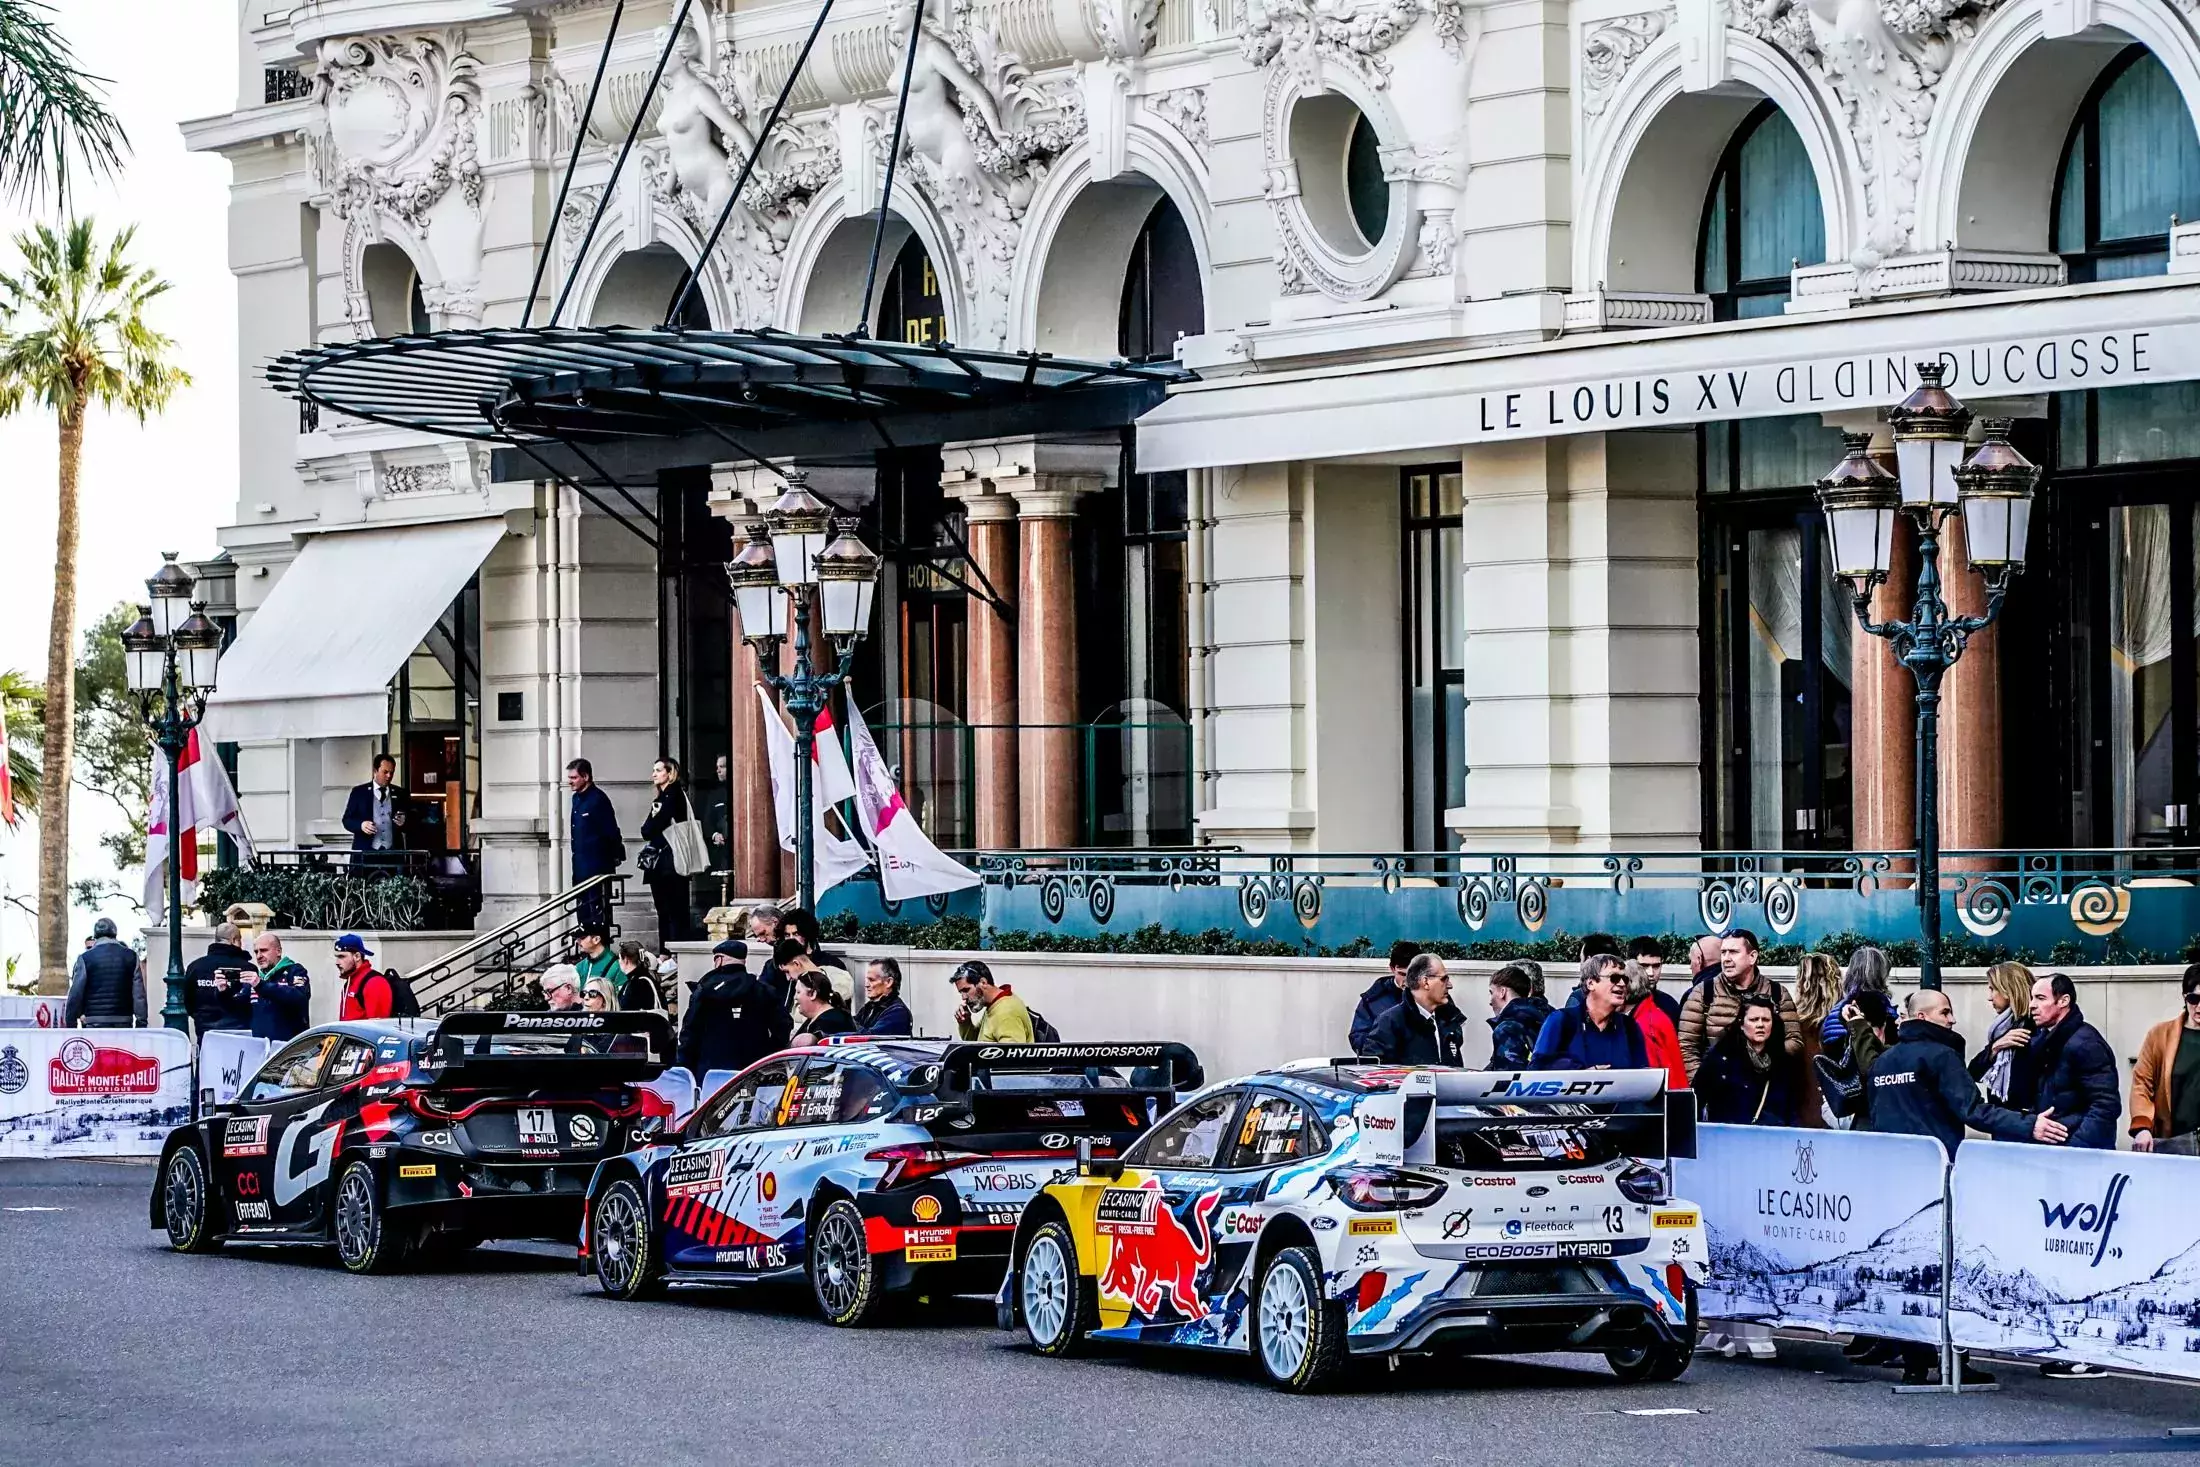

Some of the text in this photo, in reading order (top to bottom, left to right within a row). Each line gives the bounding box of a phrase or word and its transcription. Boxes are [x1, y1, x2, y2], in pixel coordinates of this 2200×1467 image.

[1481, 394, 1521, 431] LE
[1549, 378, 1670, 425] LOUIS
[1697, 371, 1748, 411] XV
[503, 1013, 605, 1028] Panasonic
[1006, 1046, 1162, 1058] HYUNDAI MOTORSPORT
[52, 1064, 156, 1088] RALLYE MONTE-CARLO
[1504, 1080, 1614, 1097] MS-RT
[777, 1075, 799, 1126] 9
[807, 1104, 835, 1117] Eriksen
[233, 1120, 257, 1134] CASINO
[526, 1110, 545, 1132] 17
[1370, 1117, 1396, 1131] Castrol
[1480, 1124, 1576, 1132] M-SPORT
[519, 1133, 547, 1144] Mobil
[848, 1141, 867, 1150] STEEL
[670, 1154, 711, 1174] LE CASINO
[961, 1165, 1007, 1174] HYUNDAI
[402, 1167, 433, 1176] PIRELLI
[670, 1171, 708, 1183] MONTE-CARLO
[973, 1173, 1037, 1192] MOBIS
[1474, 1176, 1516, 1186] Castrol
[1568, 1174, 1605, 1184] Castrol
[1101, 1192, 1144, 1208] LE CASINO
[1758, 1188, 1852, 1222] LE CASINO
[1100, 1209, 1138, 1219] MONTE-CARLO
[1494, 1205, 1580, 1214] PUMA
[1313, 1218, 1334, 1230] Ford
[1602, 1206, 1624, 1234] 13
[1656, 1215, 1694, 1226] PIRELLI
[2037, 1172, 2131, 1268] wolf
[920, 1228, 952, 1237] HYUNDAI
[1143, 1226, 1155, 1235] FUEL
[1352, 1221, 1393, 1233] PIRELLI
[1558, 1243, 1612, 1256] HYBRID
[2044, 1237, 2094, 1256] LUBRICANTS
[715, 1250, 745, 1263] HYUNDAI
[746, 1243, 787, 1269] MOBIS
[909, 1248, 952, 1260] PIRELLI
